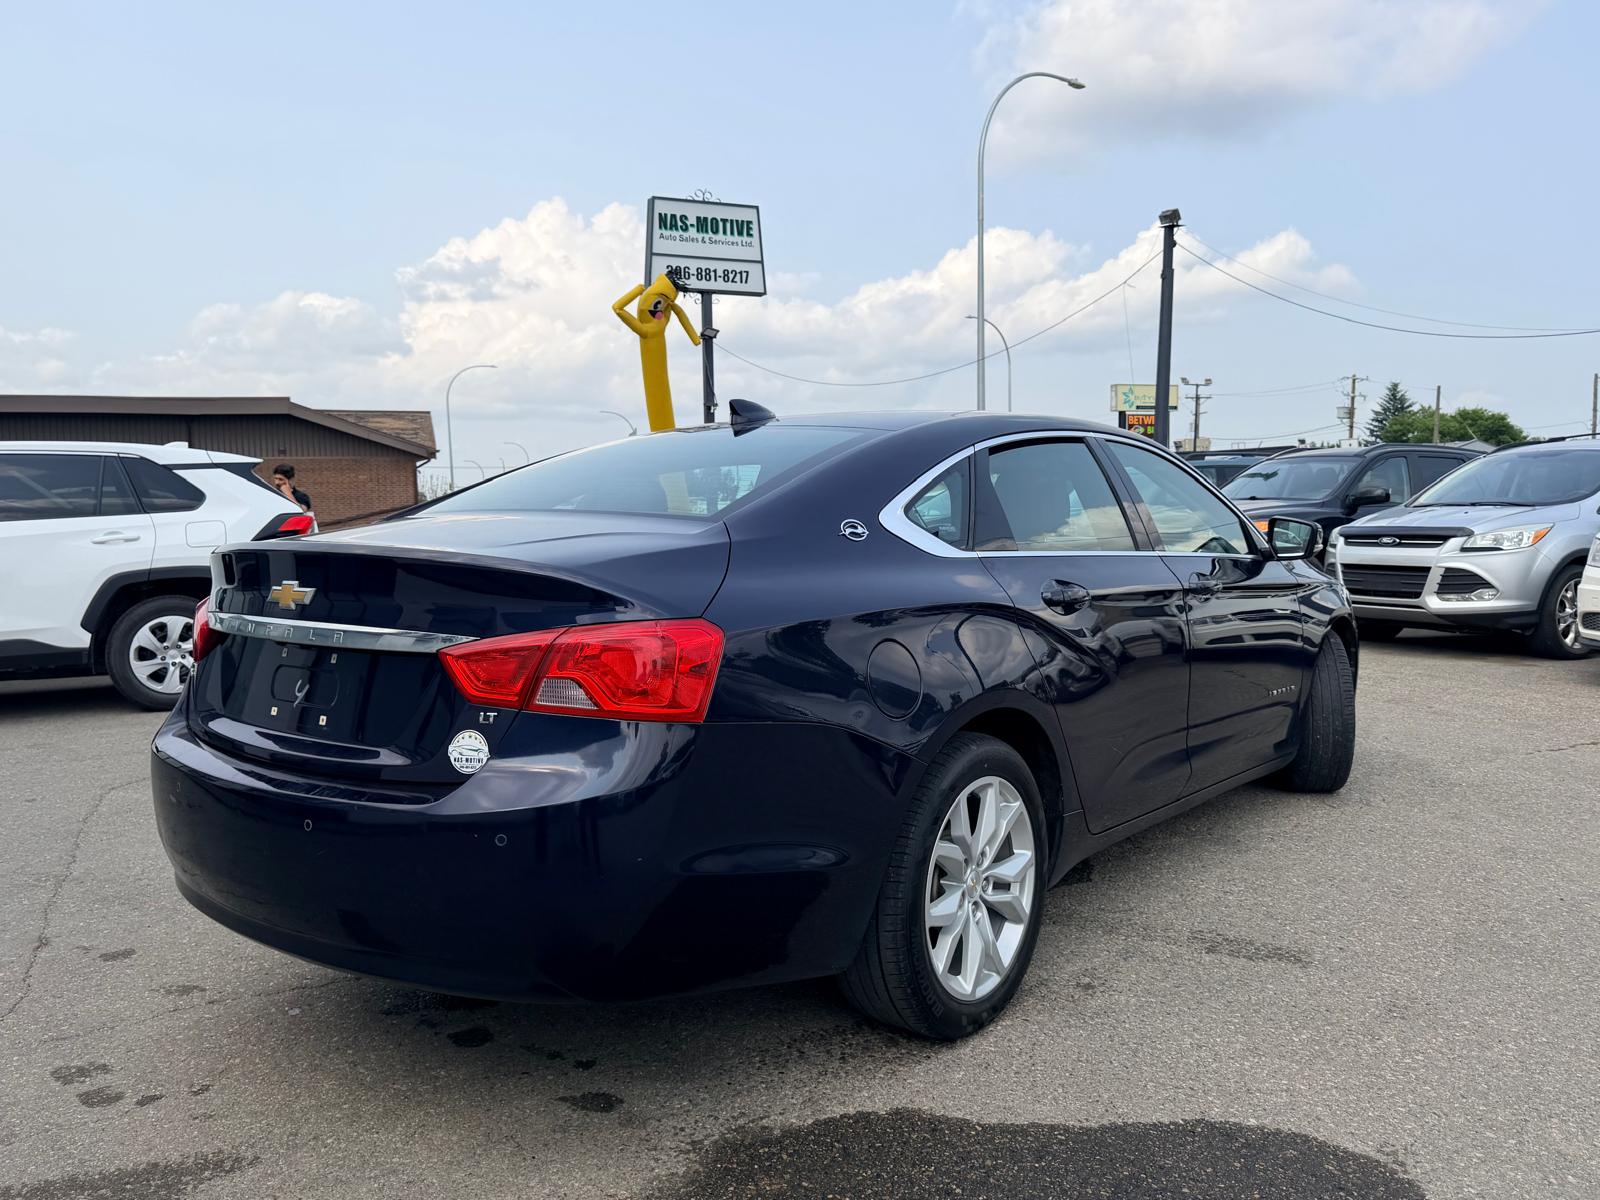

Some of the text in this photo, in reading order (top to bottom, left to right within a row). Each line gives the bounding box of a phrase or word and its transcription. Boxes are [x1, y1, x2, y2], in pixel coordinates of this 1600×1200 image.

[658, 212, 754, 238] NAS-MOTIVE
[659, 233, 754, 248] Auto Sales & Services Ltd.
[479, 712, 498, 724] LT
